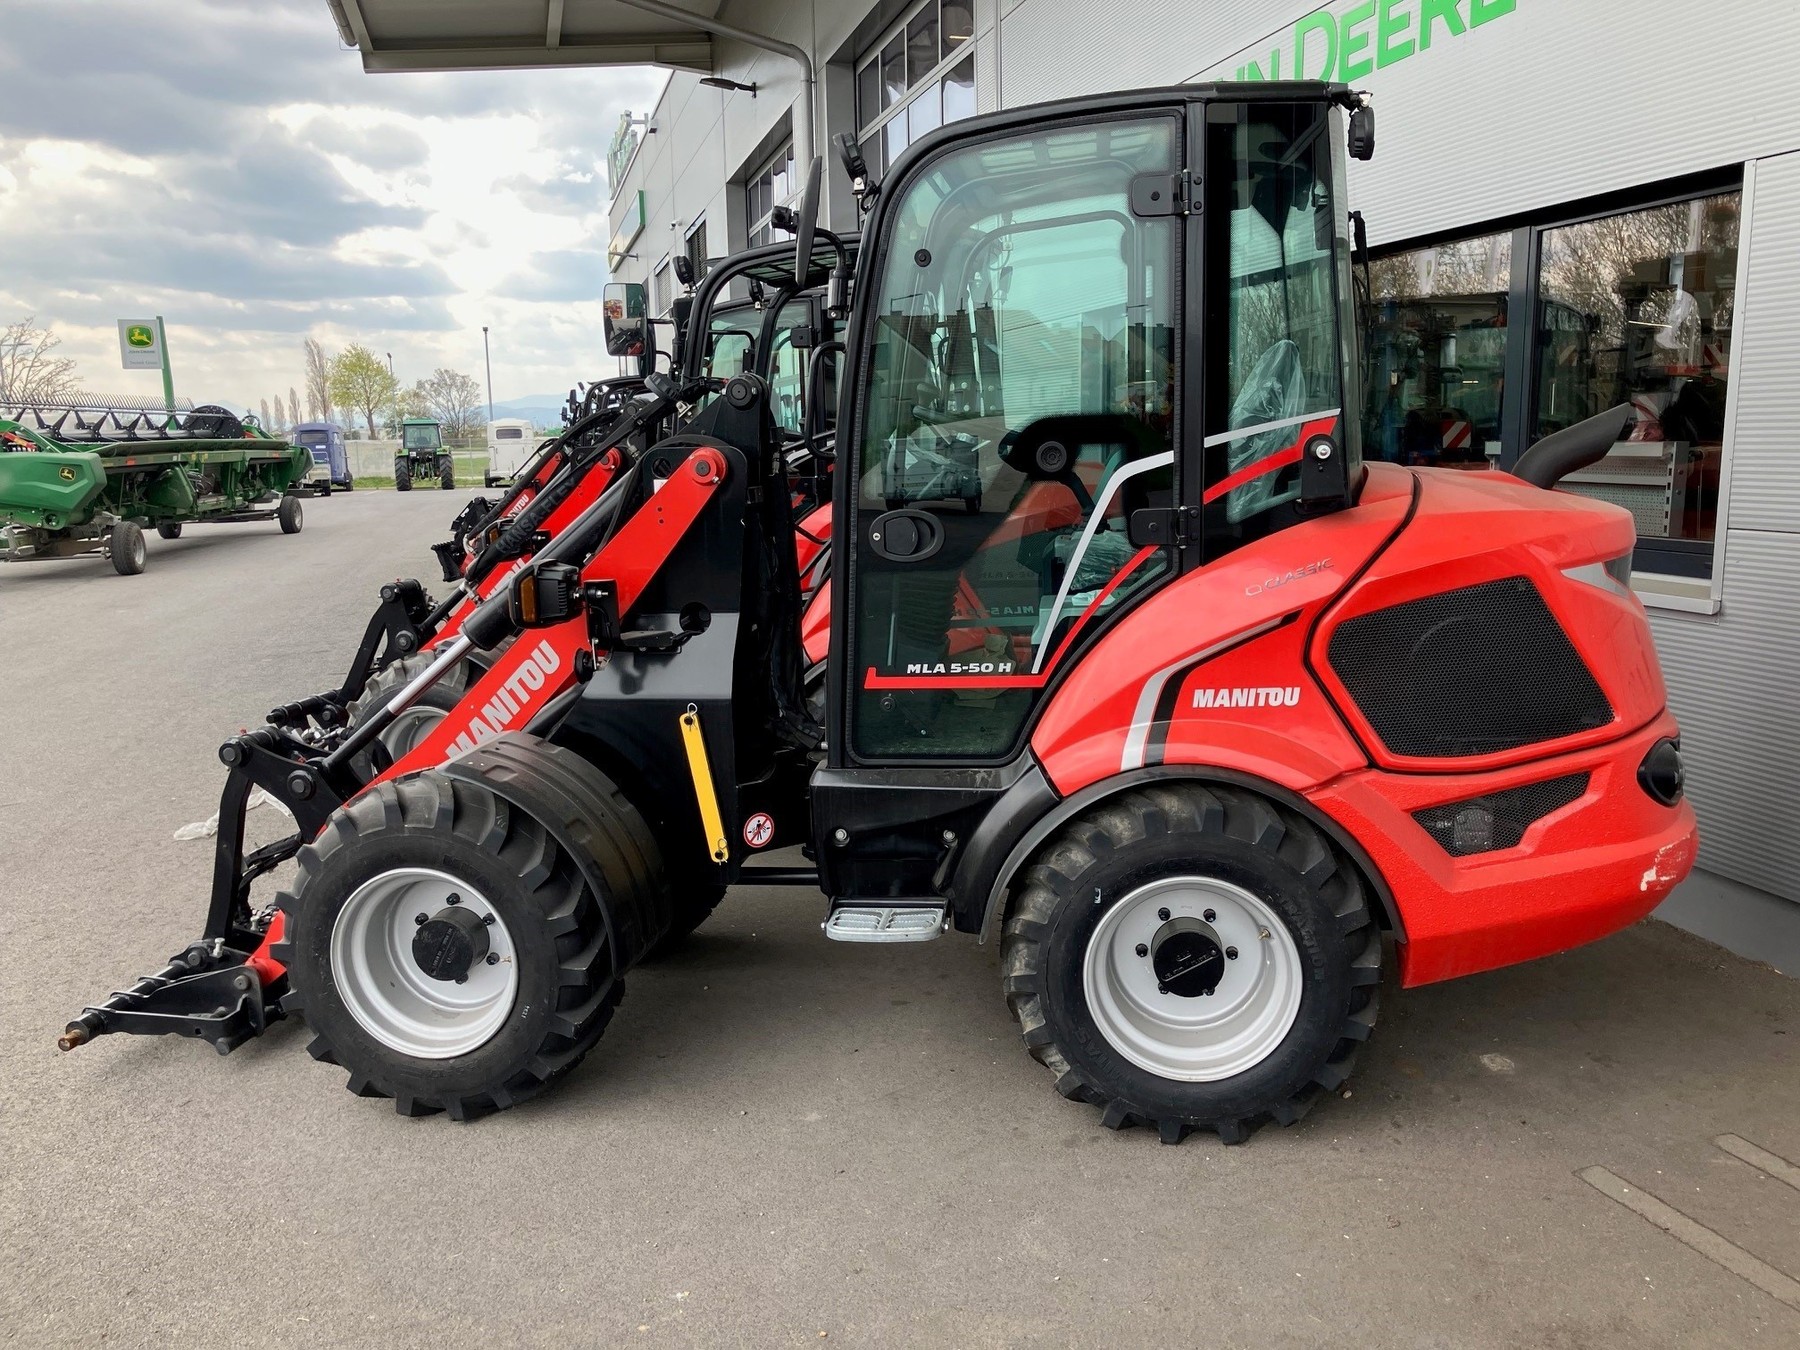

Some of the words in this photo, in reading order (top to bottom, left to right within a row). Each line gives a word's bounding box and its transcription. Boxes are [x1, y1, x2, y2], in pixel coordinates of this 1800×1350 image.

[1264, 558, 1334, 589] CLASSIC
[906, 663, 946, 674] MLA
[950, 662, 994, 673] 5-50
[998, 662, 1012, 673] H
[1192, 687, 1300, 708] MANITOU
